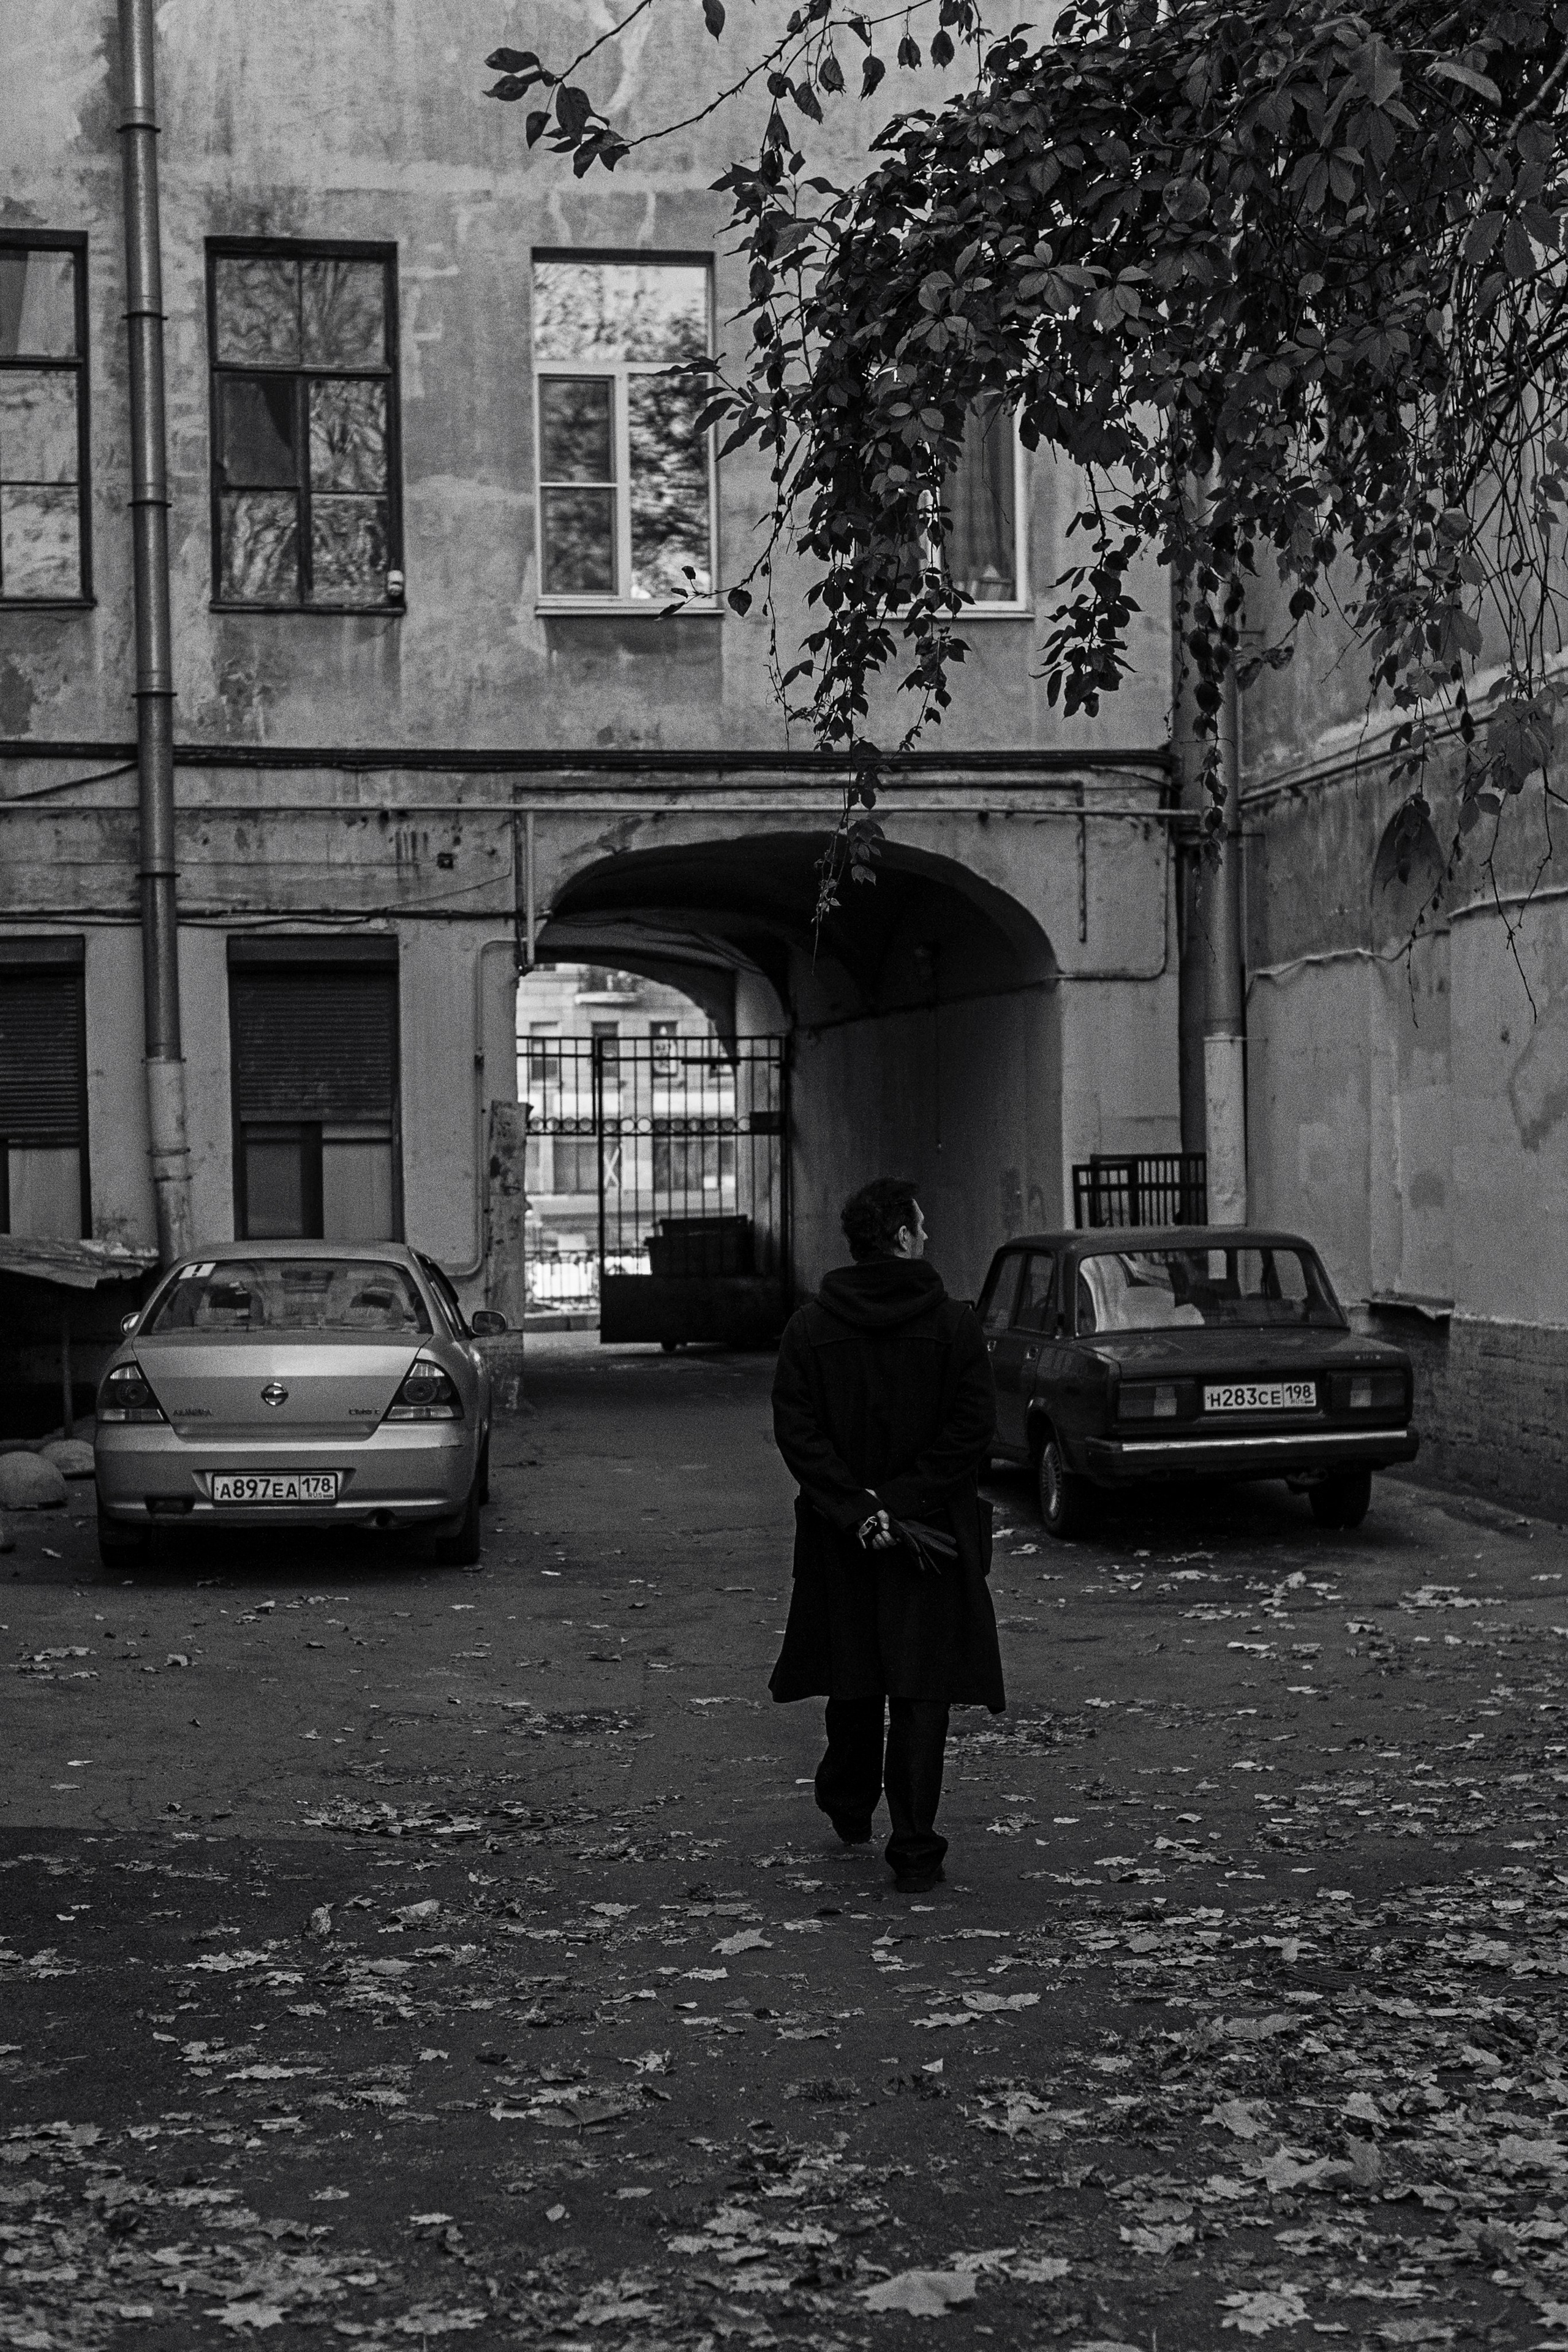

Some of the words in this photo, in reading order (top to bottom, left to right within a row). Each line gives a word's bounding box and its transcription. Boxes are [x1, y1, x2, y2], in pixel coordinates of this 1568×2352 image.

[1210, 1387, 1281, 1407] H283CE
[1285, 1385, 1311, 1399] 198
[219, 1478, 298, 1498] A897EA
[301, 1477, 331, 1493] 178
